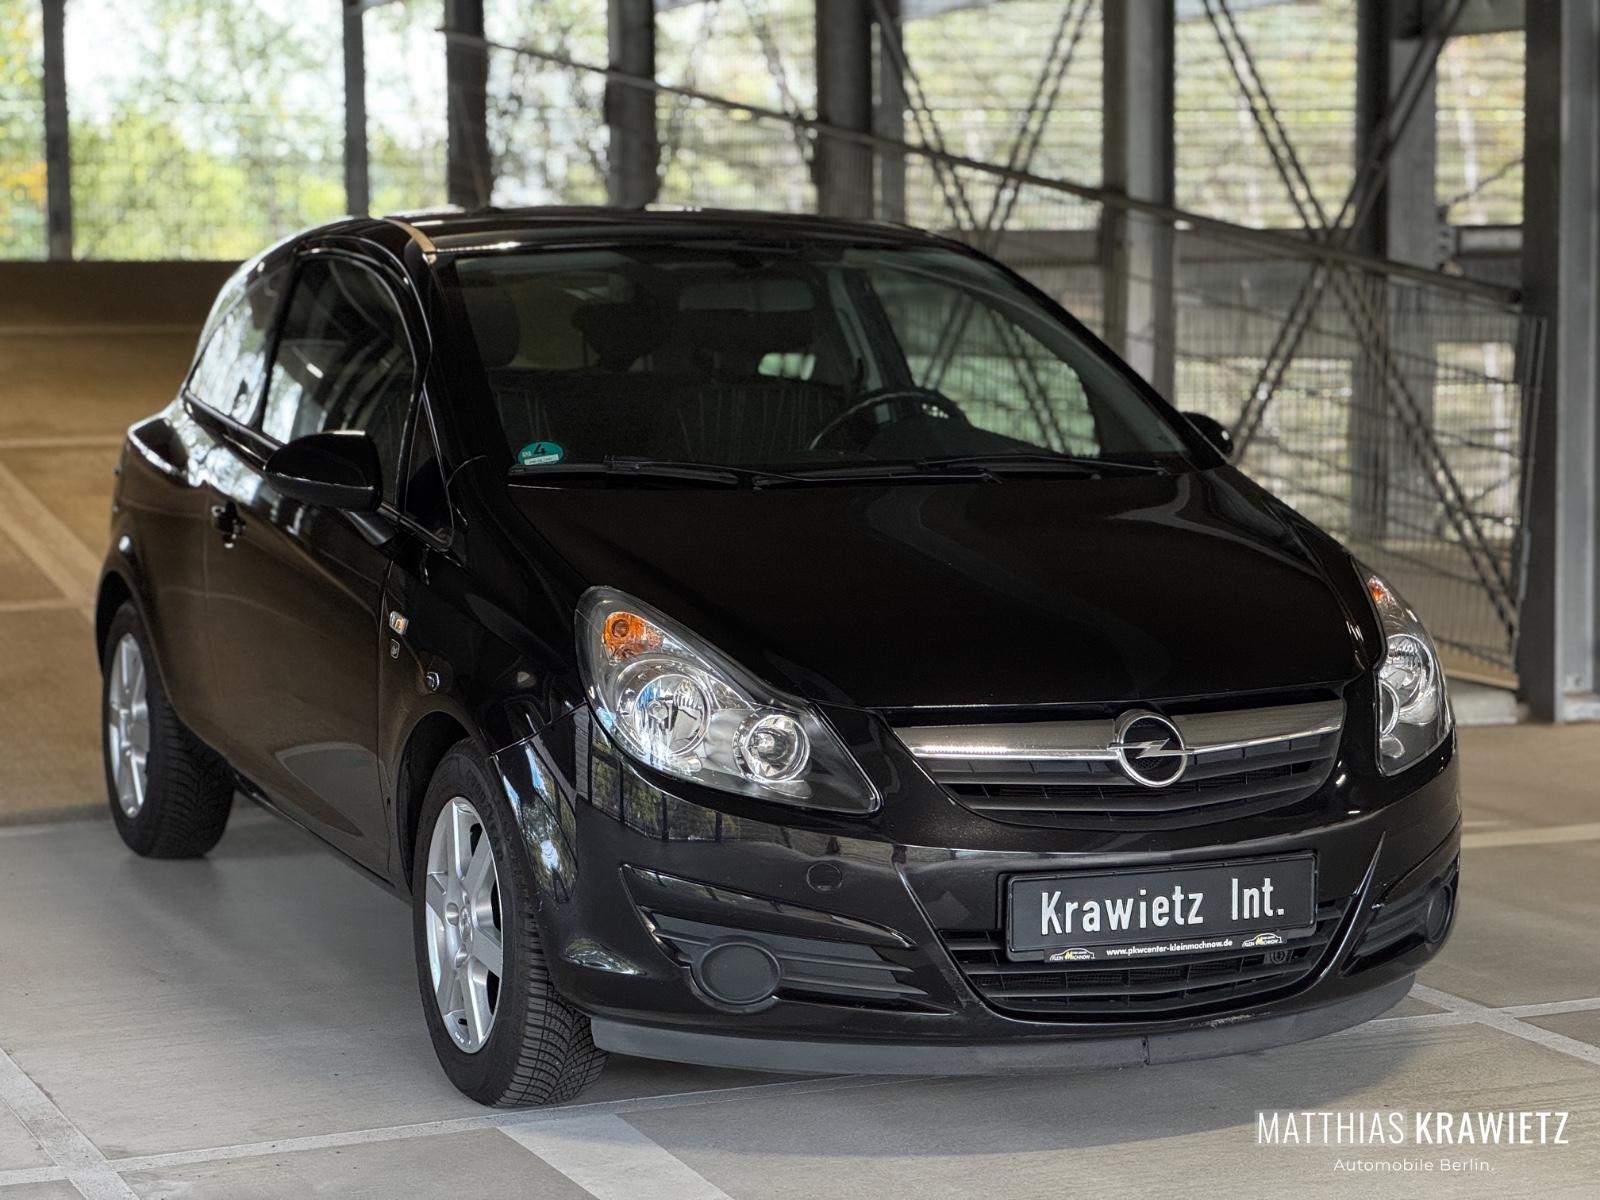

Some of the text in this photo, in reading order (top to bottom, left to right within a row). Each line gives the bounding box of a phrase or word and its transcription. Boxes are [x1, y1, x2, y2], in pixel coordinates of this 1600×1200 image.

[533, 443, 546, 455] 4
[1041, 877, 1285, 935] Krawietz Int.
